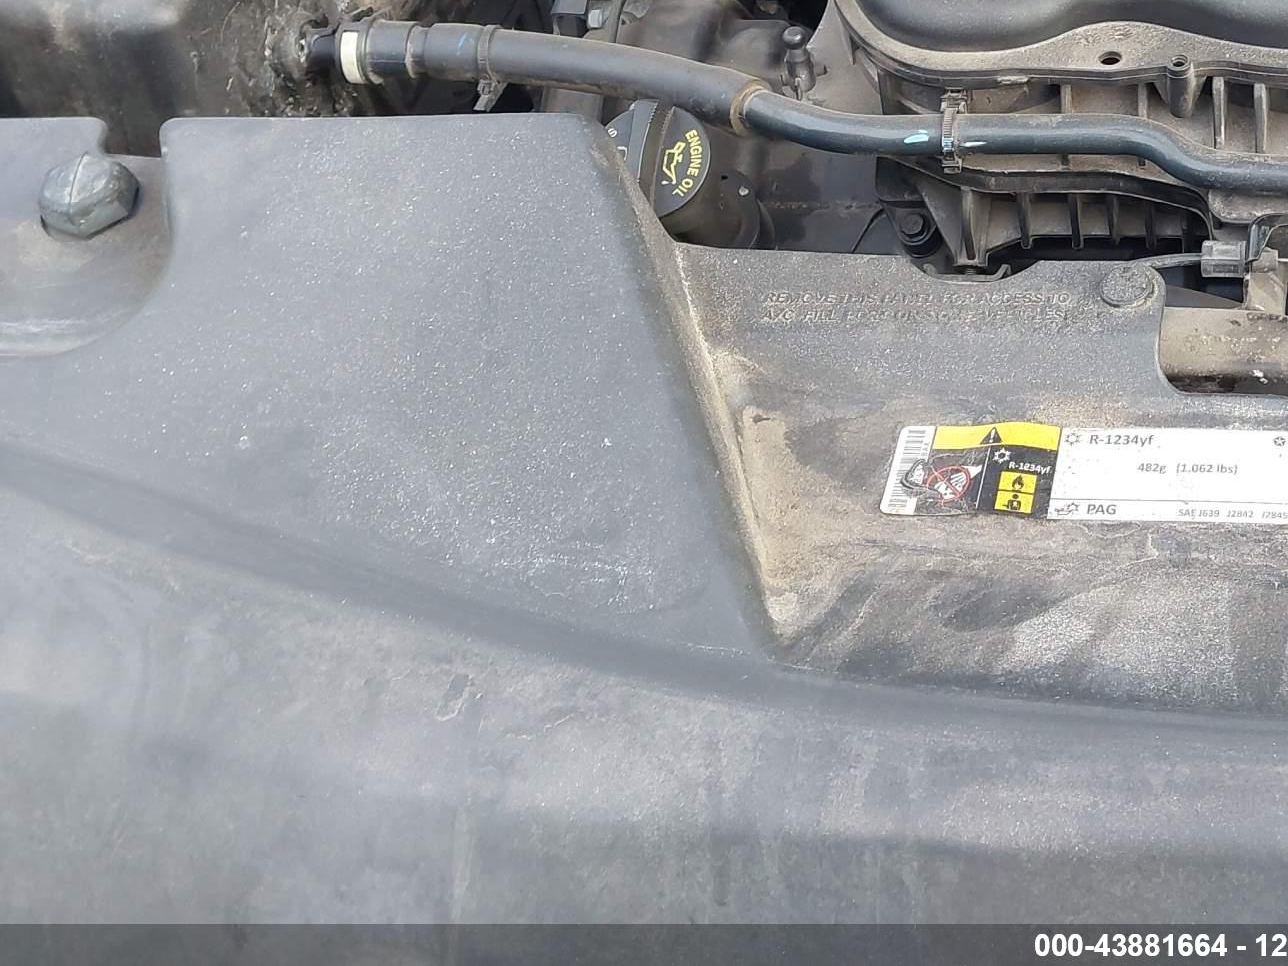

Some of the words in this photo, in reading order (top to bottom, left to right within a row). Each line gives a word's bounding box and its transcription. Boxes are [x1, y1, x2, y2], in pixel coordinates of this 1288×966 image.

[685, 129, 703, 177] ENGINE
[672, 178, 694, 197] OIL
[1089, 434, 1155, 447] R-1234yf
[1137, 462, 1167, 475] 482g
[1176, 462, 1213, 474] (1.062
[1216, 463, 1238, 475] lbs)
[1086, 503, 1117, 515] PAG
[1178, 509, 1196, 517] SAE
[1198, 509, 1220, 518] J639
[1226, 509, 1254, 518] J2842
